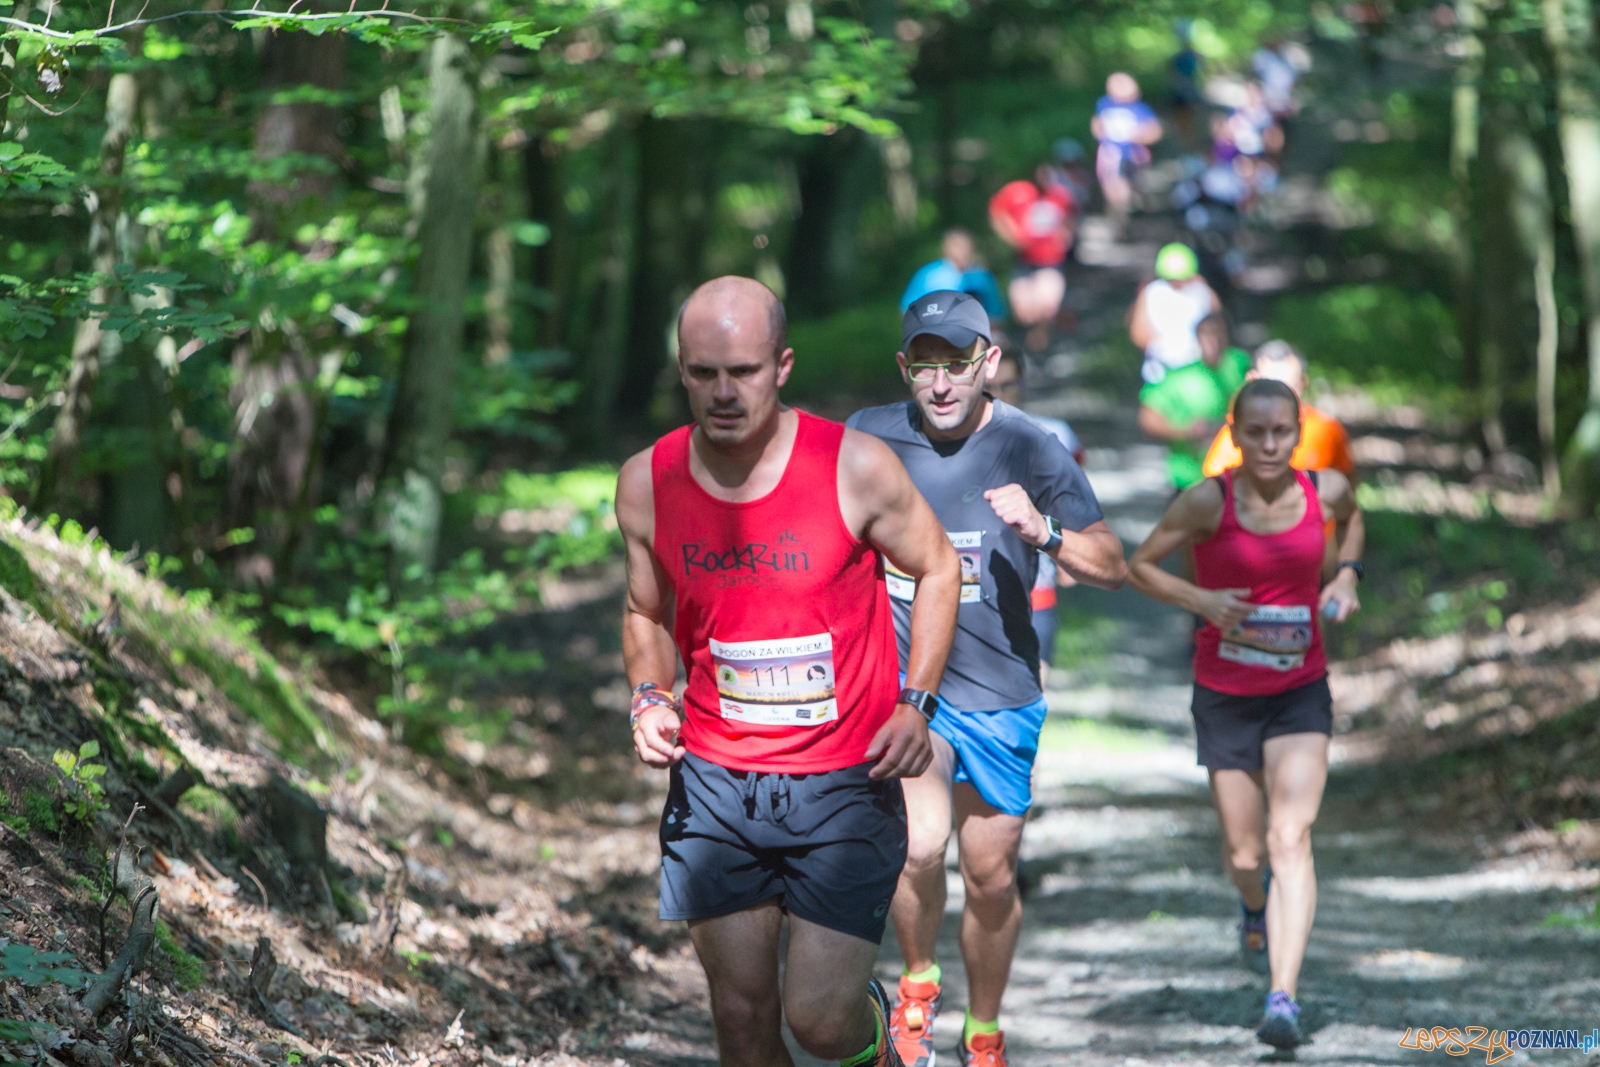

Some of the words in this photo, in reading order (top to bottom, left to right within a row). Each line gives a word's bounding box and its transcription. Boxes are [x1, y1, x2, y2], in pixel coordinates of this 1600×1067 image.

[759, 648, 773, 657] ZA
[776, 643, 823, 655] WILKIEM
[750, 664, 790, 687] 111
